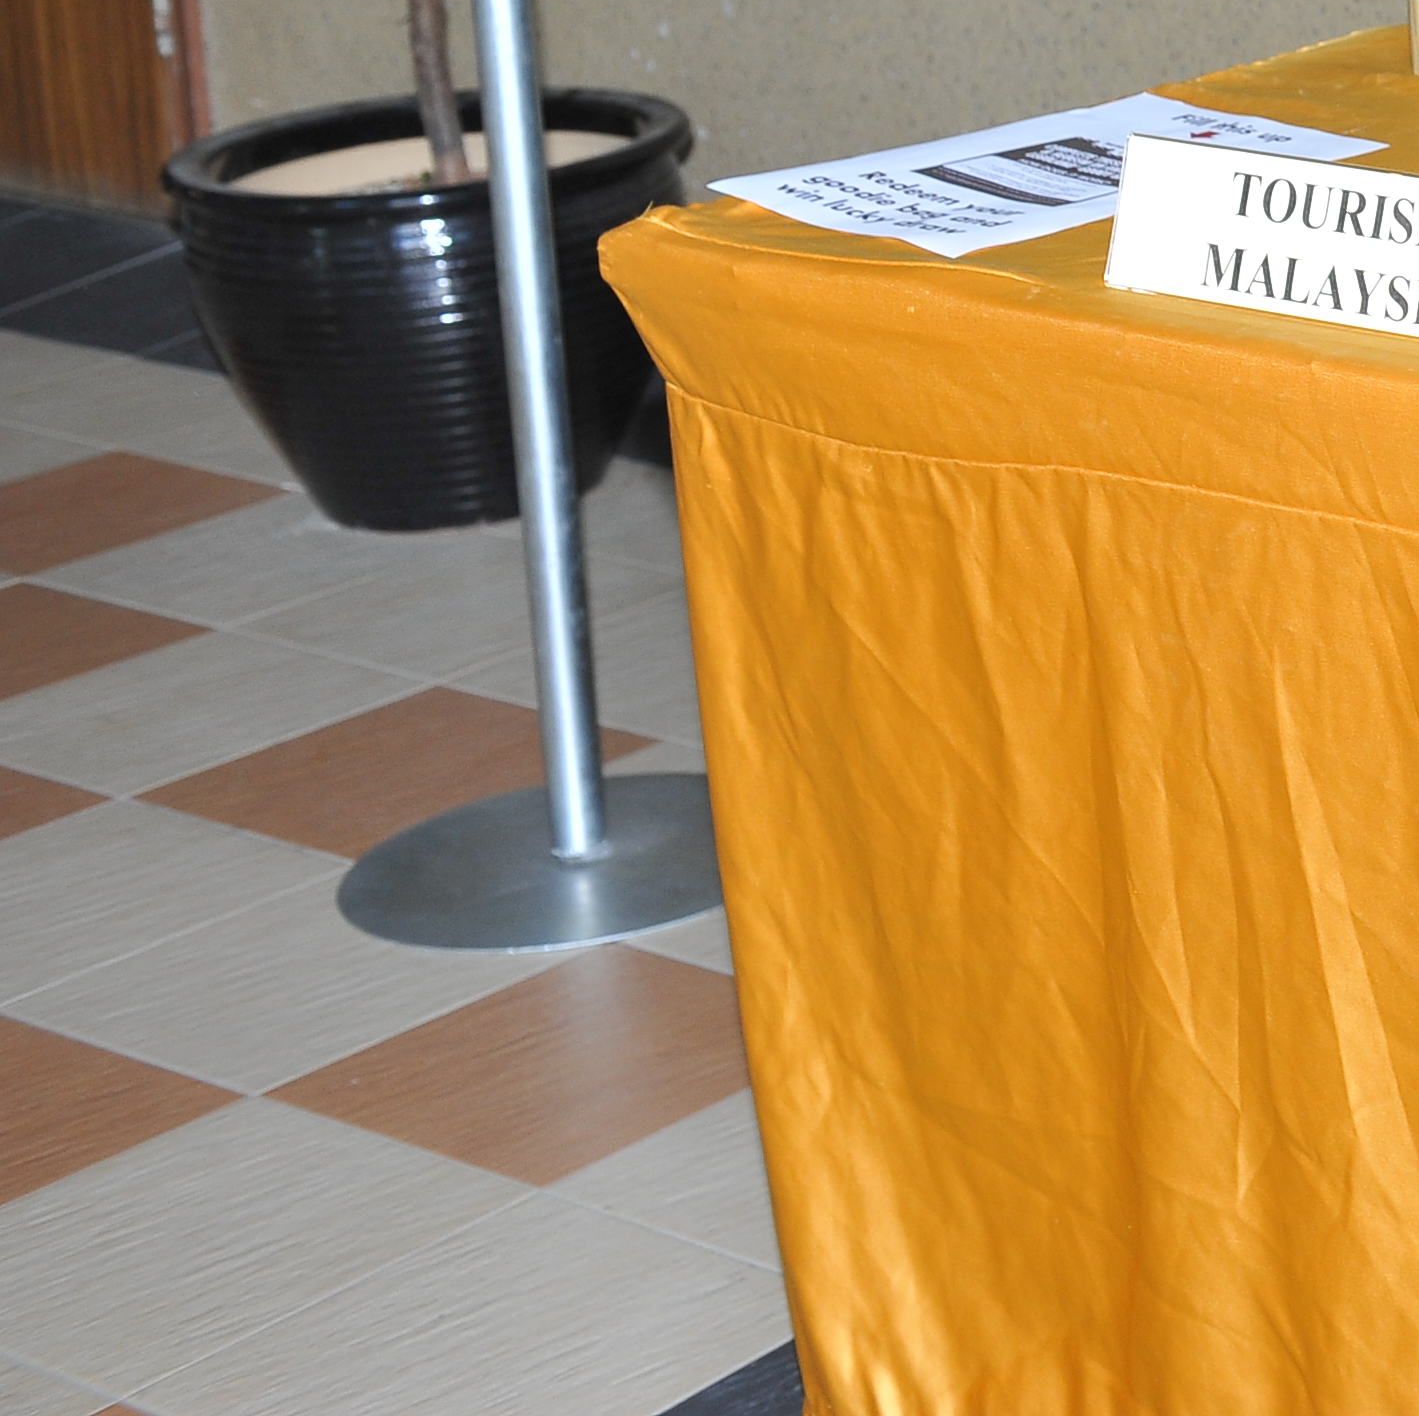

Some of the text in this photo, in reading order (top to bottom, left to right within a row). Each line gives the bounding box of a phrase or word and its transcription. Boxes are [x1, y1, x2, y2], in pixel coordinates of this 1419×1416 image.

[1218, 121, 1257, 134] this
[1257, 133, 1293, 143] up
[777, 182, 967, 234] win lucky draw
[802, 175, 1013, 228] goodie bag and
[858, 170, 960, 206] Redeem
[952, 204, 1025, 216] your
